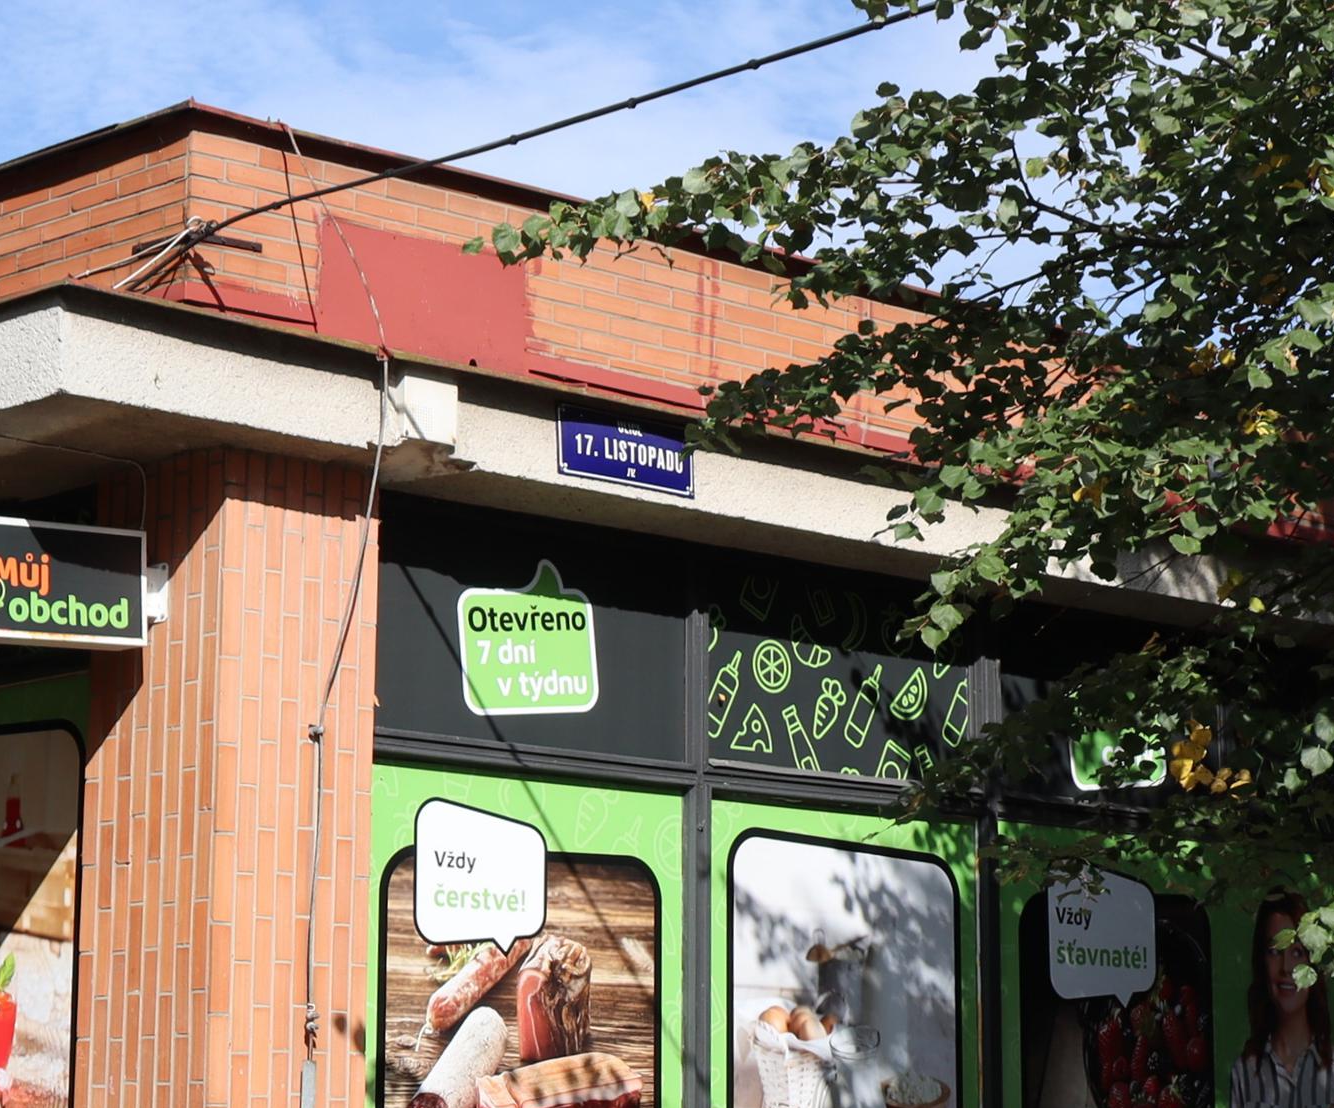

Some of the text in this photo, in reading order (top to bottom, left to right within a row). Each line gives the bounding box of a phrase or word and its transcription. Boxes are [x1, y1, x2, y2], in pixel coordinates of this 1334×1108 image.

[574, 432, 684, 475] 17. LISTOPADU
[8, 590, 129, 630] obchod
[467, 604, 587, 632] Otevřeno
[476, 637, 536, 665] 7 dní
[496, 668, 588, 703] v týdnu
[434, 850, 477, 874] Vždy
[433, 883, 526, 913] čerstvé!
[1055, 906, 1093, 931] Vždy
[1056, 938, 1148, 969] šťavnaté!
